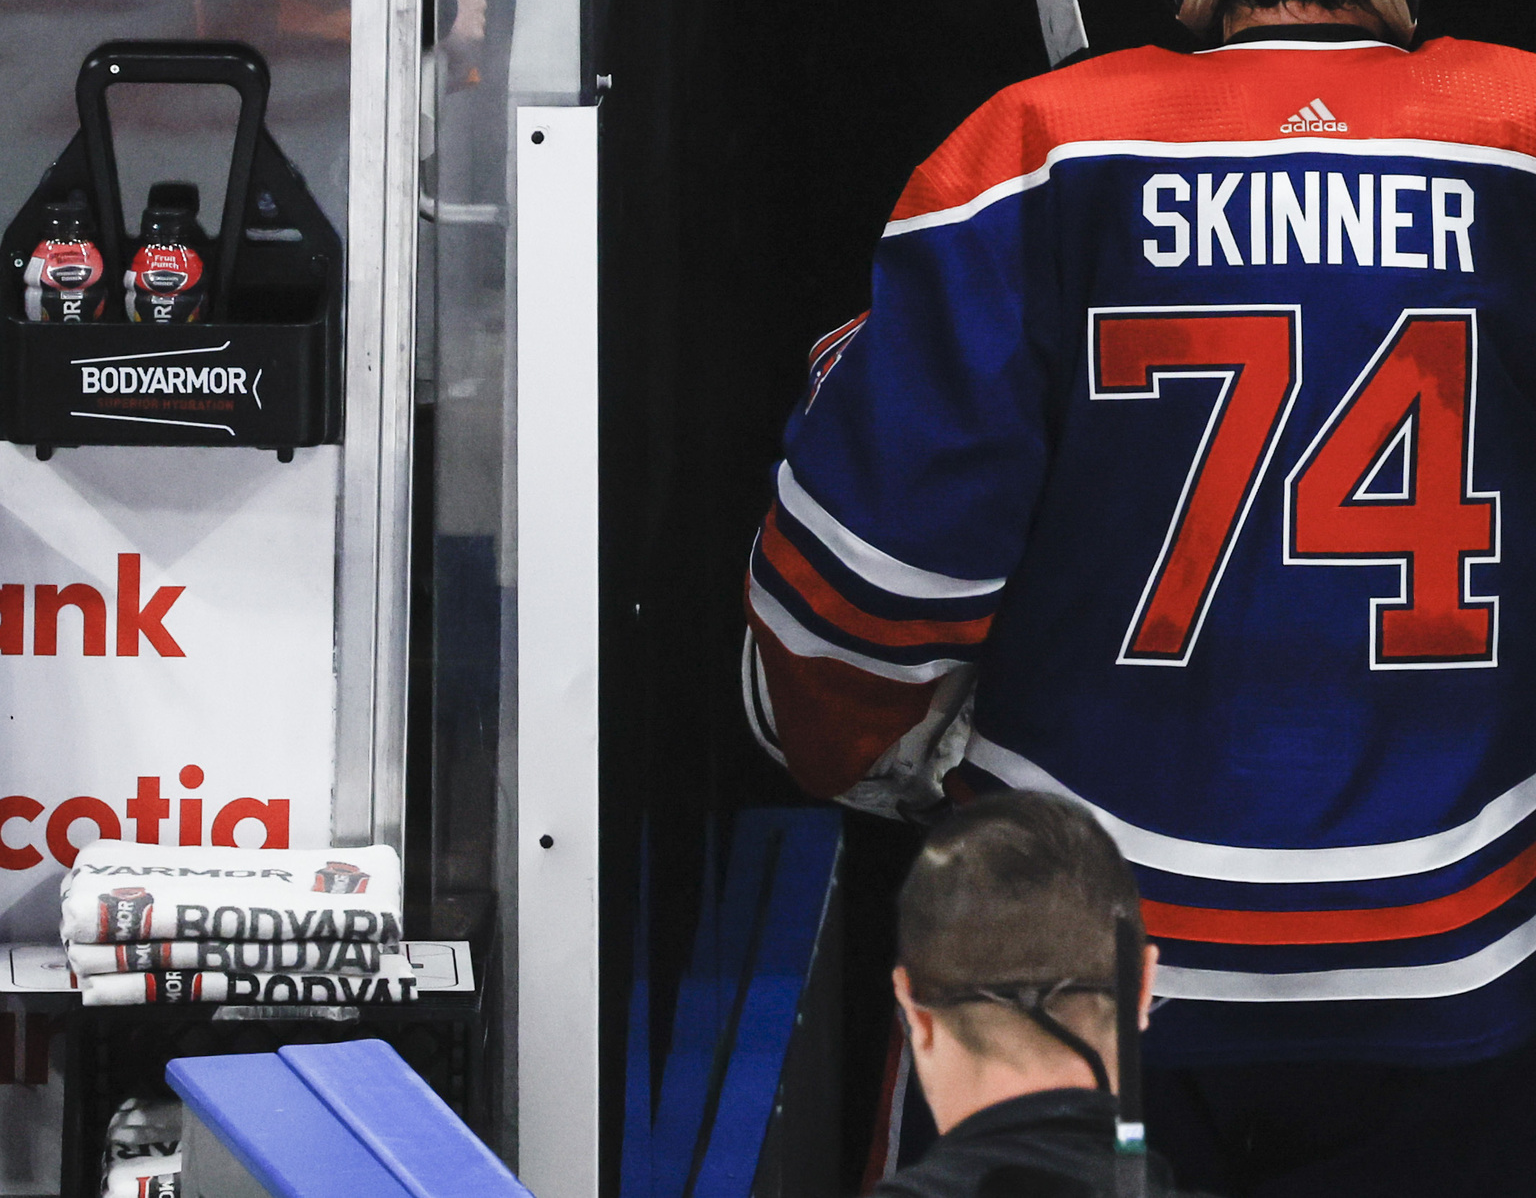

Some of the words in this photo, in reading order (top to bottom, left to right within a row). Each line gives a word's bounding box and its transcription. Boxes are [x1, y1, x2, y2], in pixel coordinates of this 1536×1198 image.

[1279, 119, 1348, 134] adidas
[1143, 172, 1475, 272] SKINNER
[154, 254, 177, 263] Fruit
[81, 367, 248, 394] BODYARMOR
[97, 397, 160, 409] SUPERIOR
[1087, 304, 1501, 671] 74
